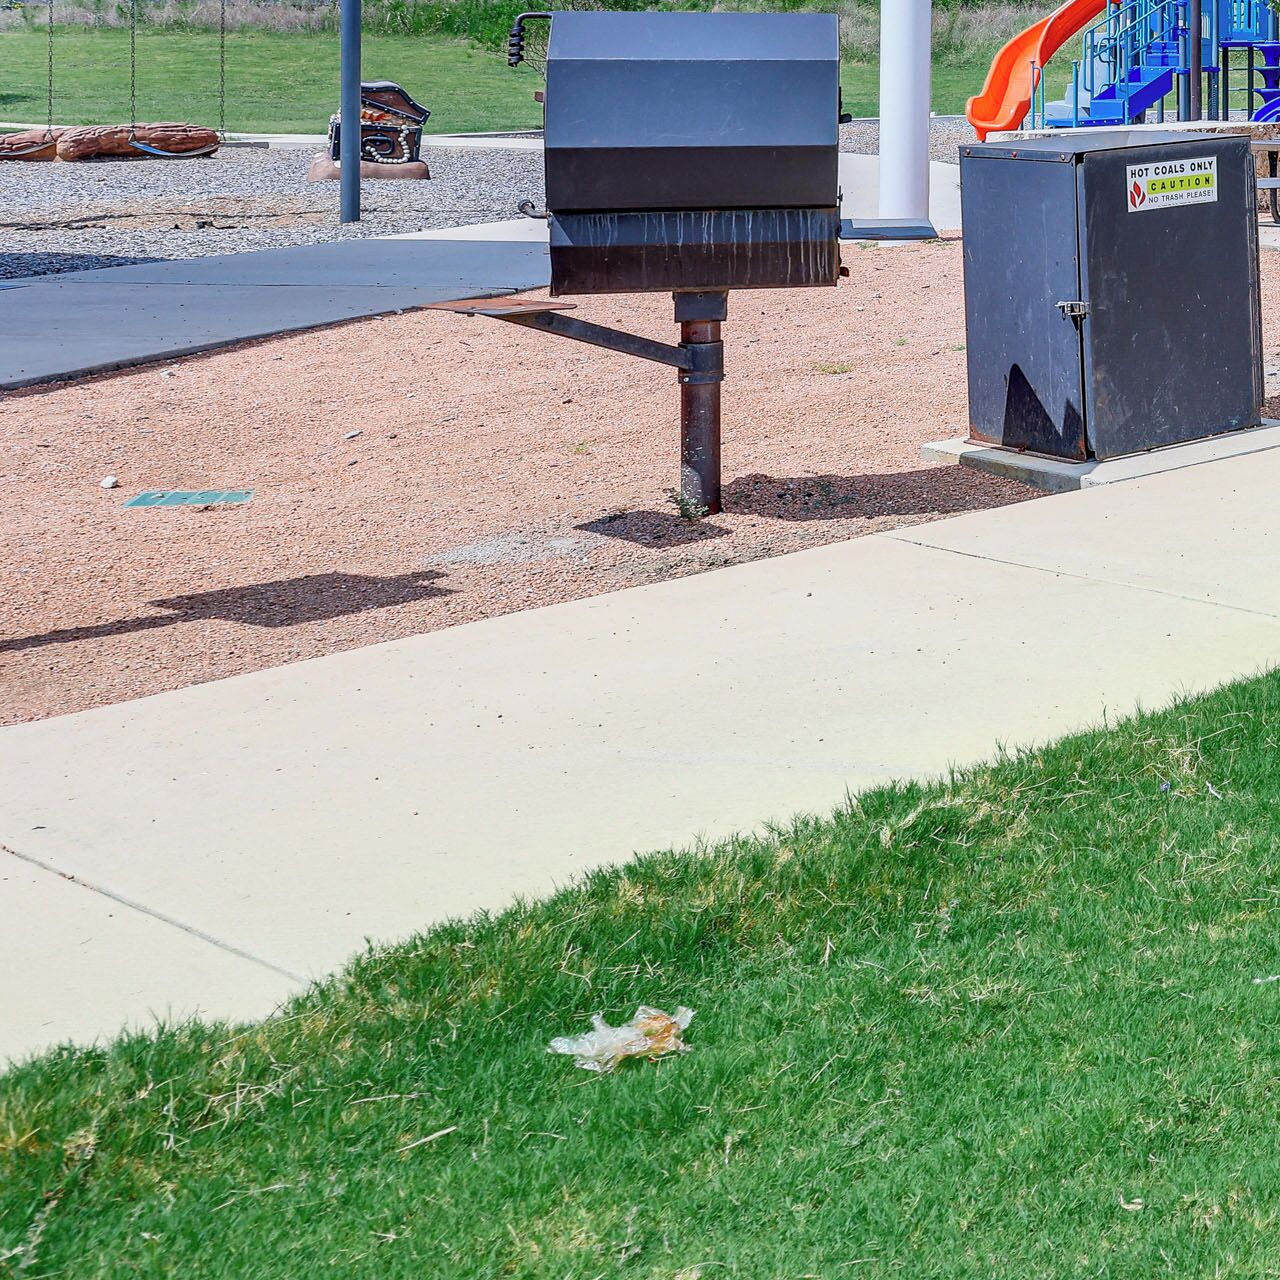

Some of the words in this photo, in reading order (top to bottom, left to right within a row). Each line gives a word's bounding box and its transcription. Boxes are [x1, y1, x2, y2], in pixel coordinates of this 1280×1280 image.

[1130, 167, 1149, 179] HOT
[1154, 163, 1185, 176] COALS
[1190, 160, 1214, 172] ONLY
[1151, 176, 1210, 191] CAUTION
[1148, 196, 1159, 204] NO
[1162, 193, 1184, 202] TRASH
[1186, 189, 1215, 199] PLEASE!
